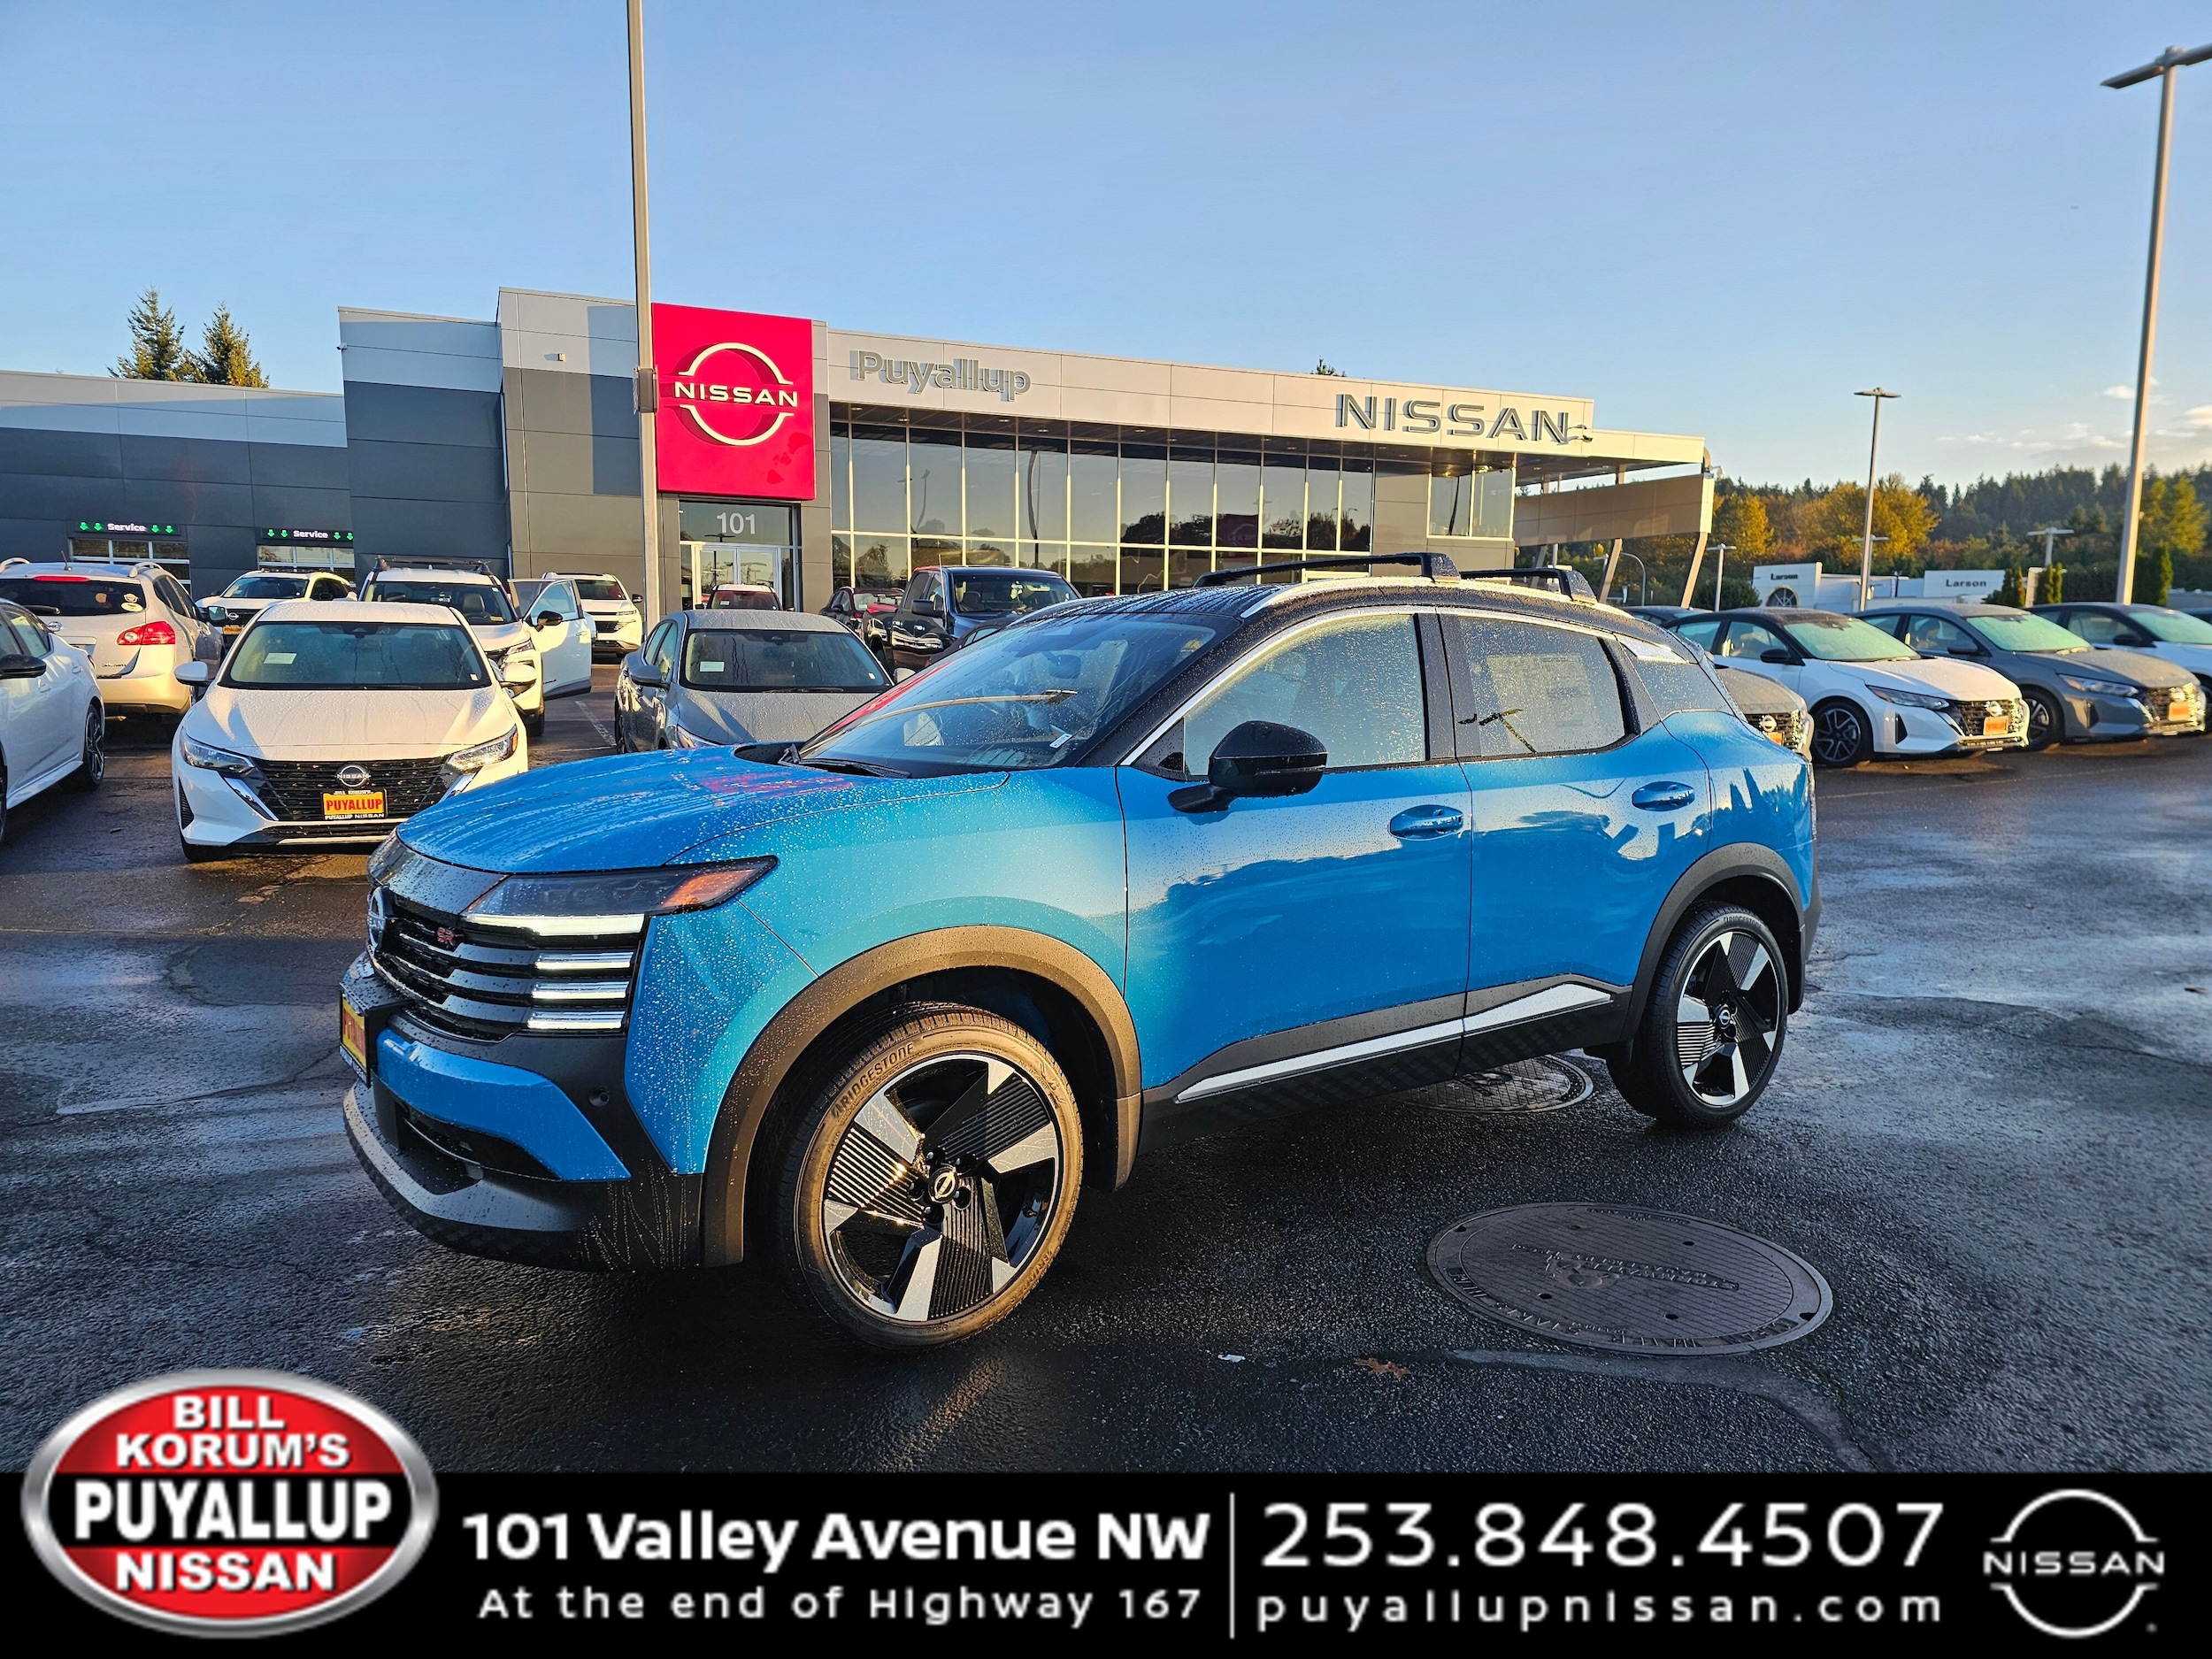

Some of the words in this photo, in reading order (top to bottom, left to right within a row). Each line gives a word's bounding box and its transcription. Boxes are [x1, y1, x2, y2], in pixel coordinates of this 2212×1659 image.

[850, 349, 1032, 402] Puyallup
[674, 380, 798, 408] NISSAN
[1336, 393, 1570, 443] NISSAN
[107, 522, 147, 533] Service
[716, 511, 757, 535] 101
[293, 529, 328, 540] Service
[1946, 578, 1987, 588] Larson
[326, 798, 383, 811] PUYALLUP
